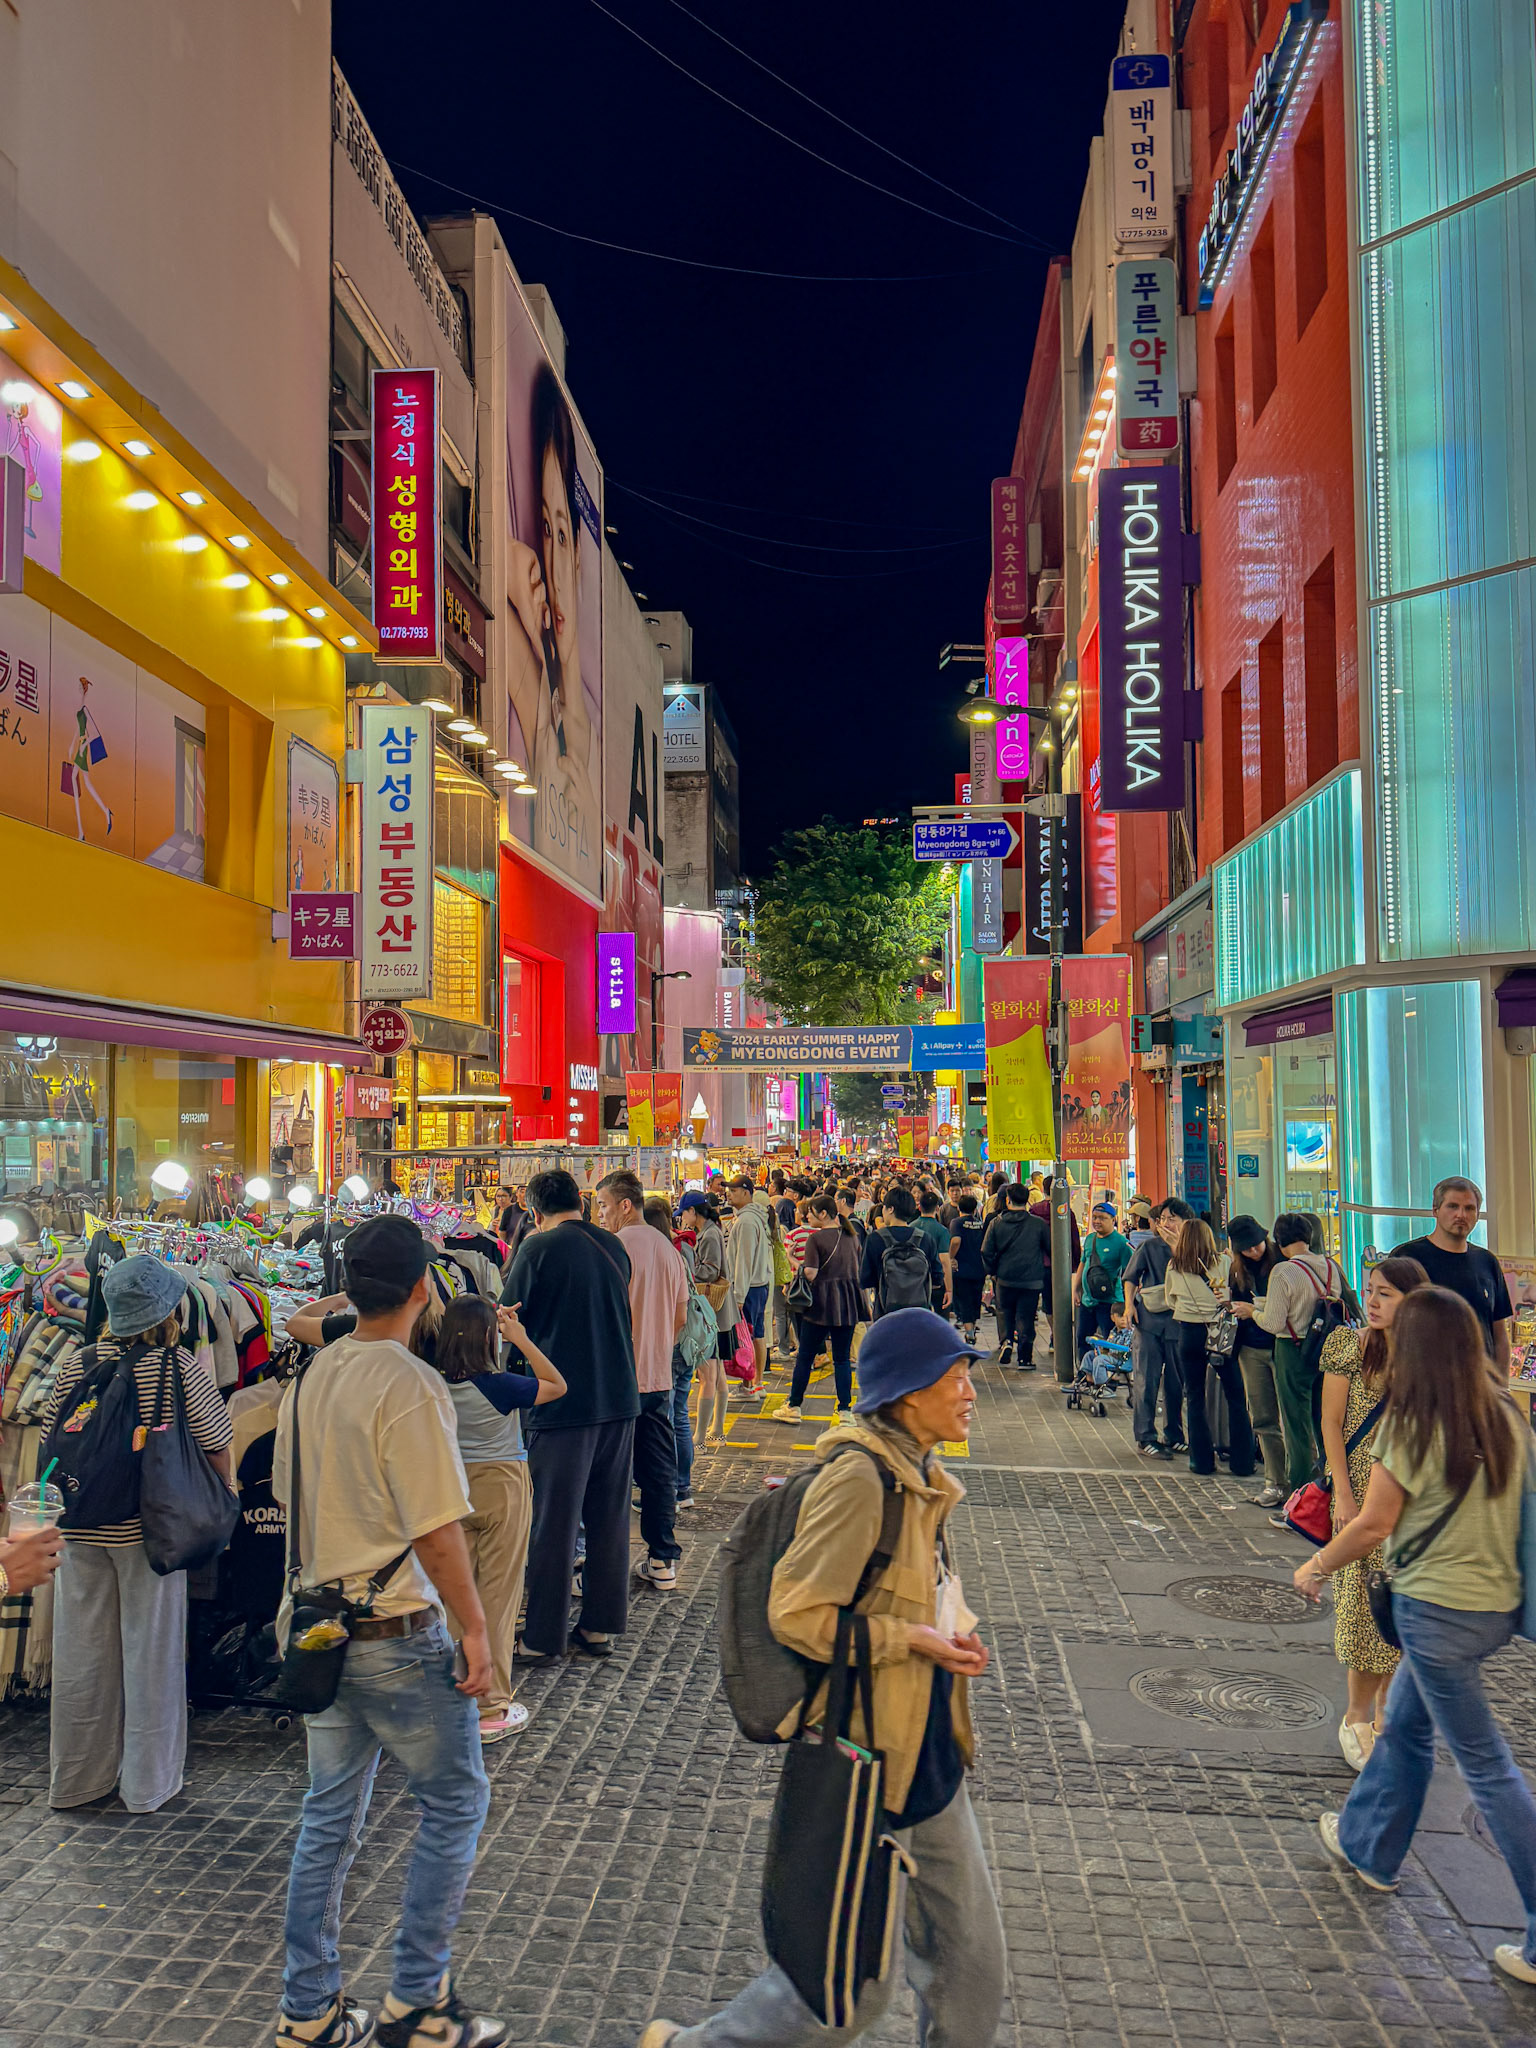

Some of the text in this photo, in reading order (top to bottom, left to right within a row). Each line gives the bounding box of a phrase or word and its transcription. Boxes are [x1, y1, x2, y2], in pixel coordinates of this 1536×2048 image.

[1129, 98, 1155, 202] 백명기
[1131, 206, 1157, 221] 의원
[1120, 228, 1168, 239] T.775-9238
[1129, 272, 1167, 408] 푸른약국
[391, 388, 420, 467] 노정식
[1138, 420, 1163, 444] 药
[1001, 485, 1019, 538] 제일사
[387, 475, 423, 616] 성형외과
[380, 626, 429, 639] 02.778-7933
[1123, 483, 1162, 791] HOLIKA HOLIKA
[298, 783, 331, 828] キラ星
[304, 822, 326, 849] かばん
[917, 824, 968, 839] 명동8가길
[917, 838, 1000, 850] Myeongdong 8ga-gil
[982, 883, 992, 924] HAIR
[293, 906, 352, 928] キラ星
[301, 934, 344, 948] かばん
[370, 963, 418, 977] 773-6622
[609, 956, 624, 1009] stila
[989, 999, 1042, 1020] 활화산
[1068, 997, 1121, 1018] 활화산
[364, 1028, 406, 1047] 성형외과
[731, 1033, 900, 1046] 2024 EARLY SUMMER HAPPY
[731, 1045, 900, 1060] MYEONGDONG EVENT
[570, 1062, 599, 1092] MISSHA
[255, 1523, 286, 1535] ARMY
